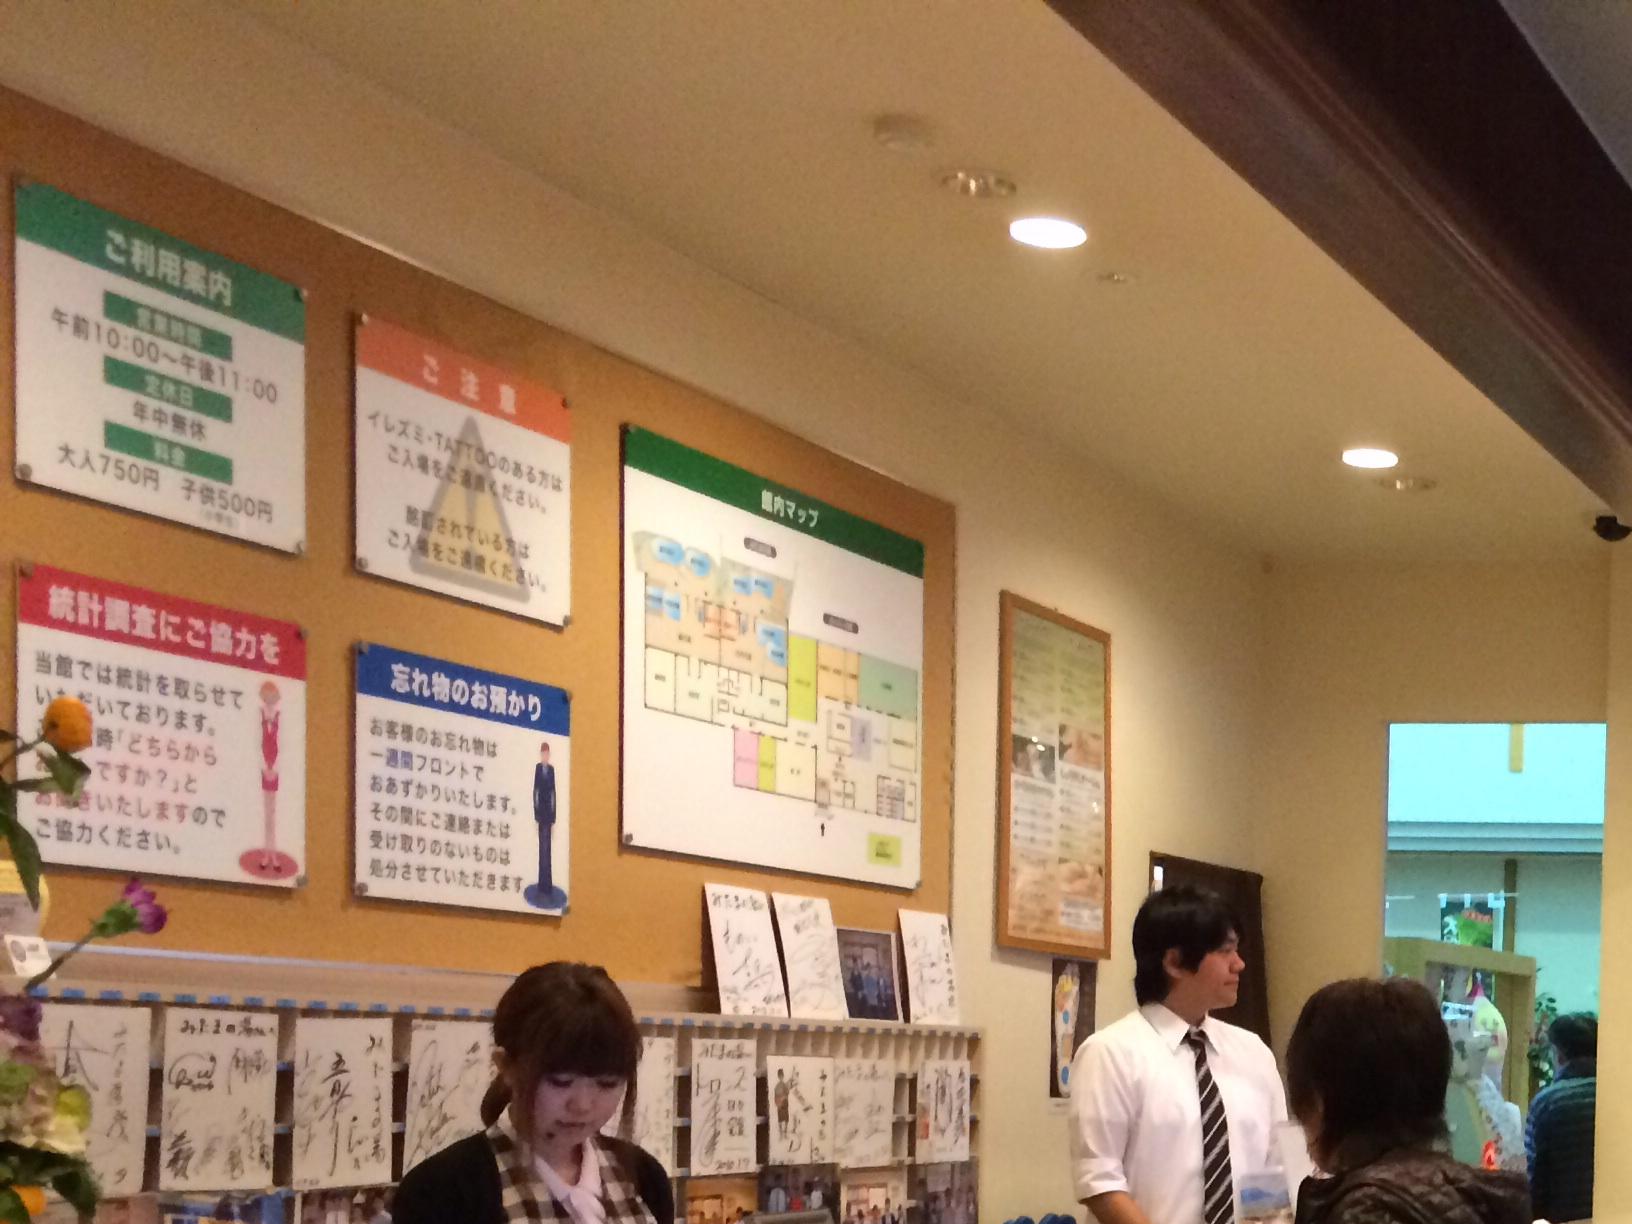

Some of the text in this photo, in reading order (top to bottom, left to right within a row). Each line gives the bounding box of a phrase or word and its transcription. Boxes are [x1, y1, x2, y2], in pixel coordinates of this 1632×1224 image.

[105, 230, 232, 306] ご利用案内
[133, 401, 206, 440] 年中無休
[58, 443, 273, 523] 大人750円 子供500円
[48, 585, 280, 665] 統計調査にご協力を
[35, 651, 244, 710] 当館では統計を取らせて
[391, 662, 541, 722] 忘れ物のお預かり
[370, 718, 498, 757] お客様のお忘れ物は
[371, 749, 485, 780] 一週間フロントで
[370, 775, 517, 816] おあずかりいたします。
[36, 817, 180, 854] ご協力ください。
[370, 801, 510, 840] その間にご連絡または
[370, 829, 511, 866] 受け取りのないものは
